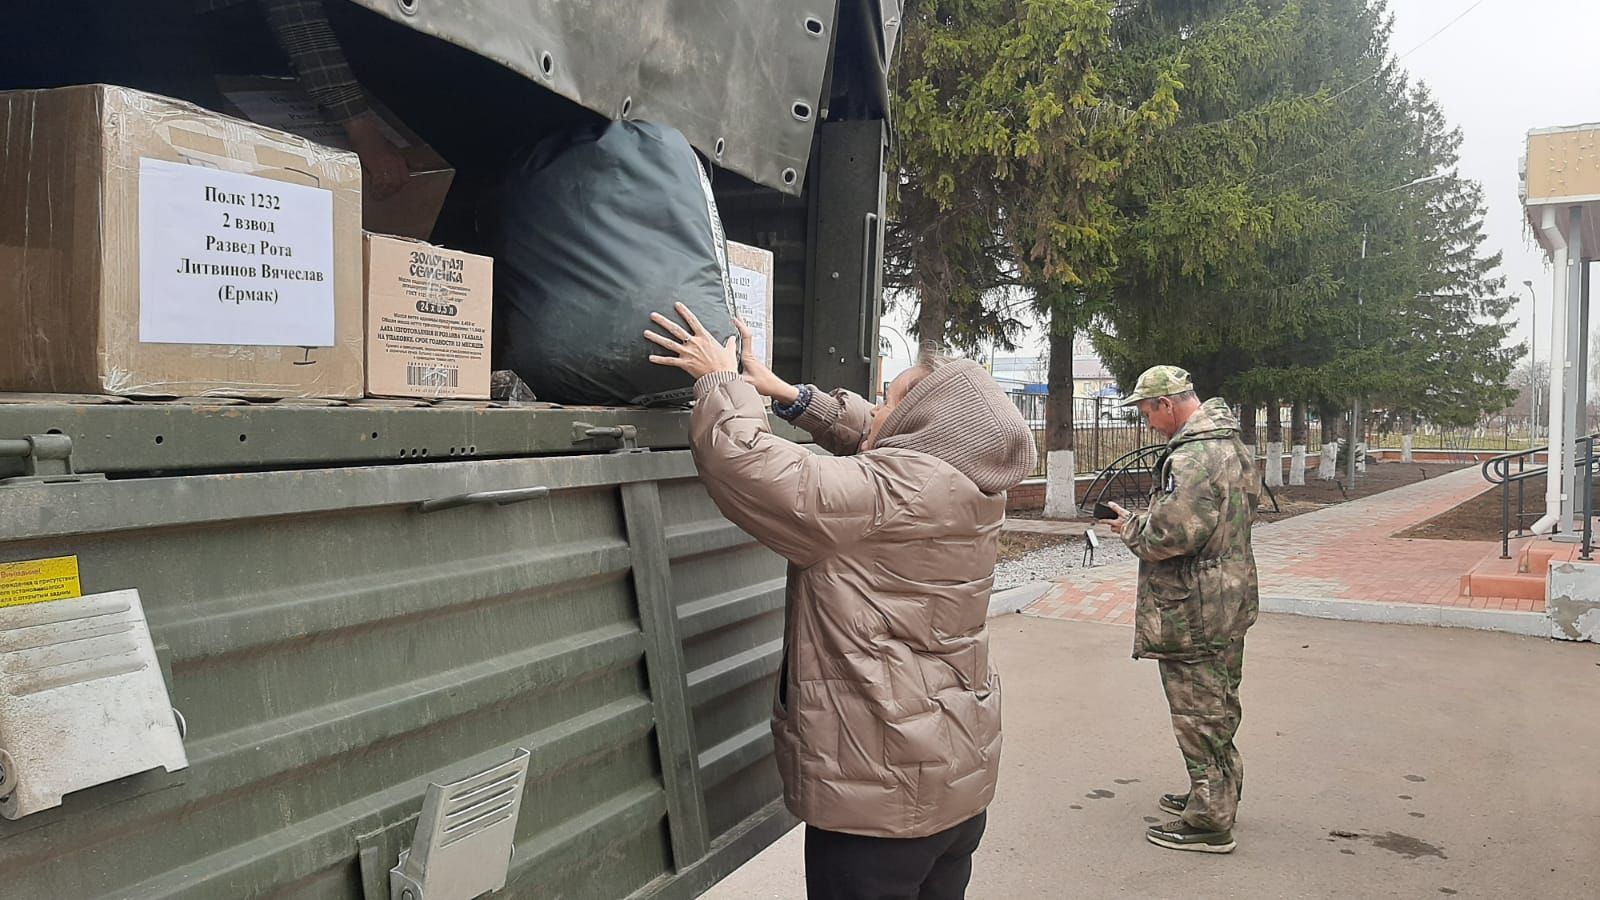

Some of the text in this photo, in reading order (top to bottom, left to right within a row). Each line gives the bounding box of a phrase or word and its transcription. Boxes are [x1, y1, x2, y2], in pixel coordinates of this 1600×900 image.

[205, 186, 281, 210] Полк 1232
[222, 212, 275, 234] 2 взвод
[206, 235, 292, 257] Развед Рота
[176, 258, 324, 282] Литвинов Вячеслав
[409, 251, 464, 271] ЗОЛОТАЯ
[218, 285, 279, 305] (Ермак)
[420, 302, 429, 312] 24
[394, 326, 433, 336] ИЗГОТОВЛЕНИЯ
[429, 338, 455, 346] ГОДНОСТИ
[0, 568, 41, 578] Внимание!
